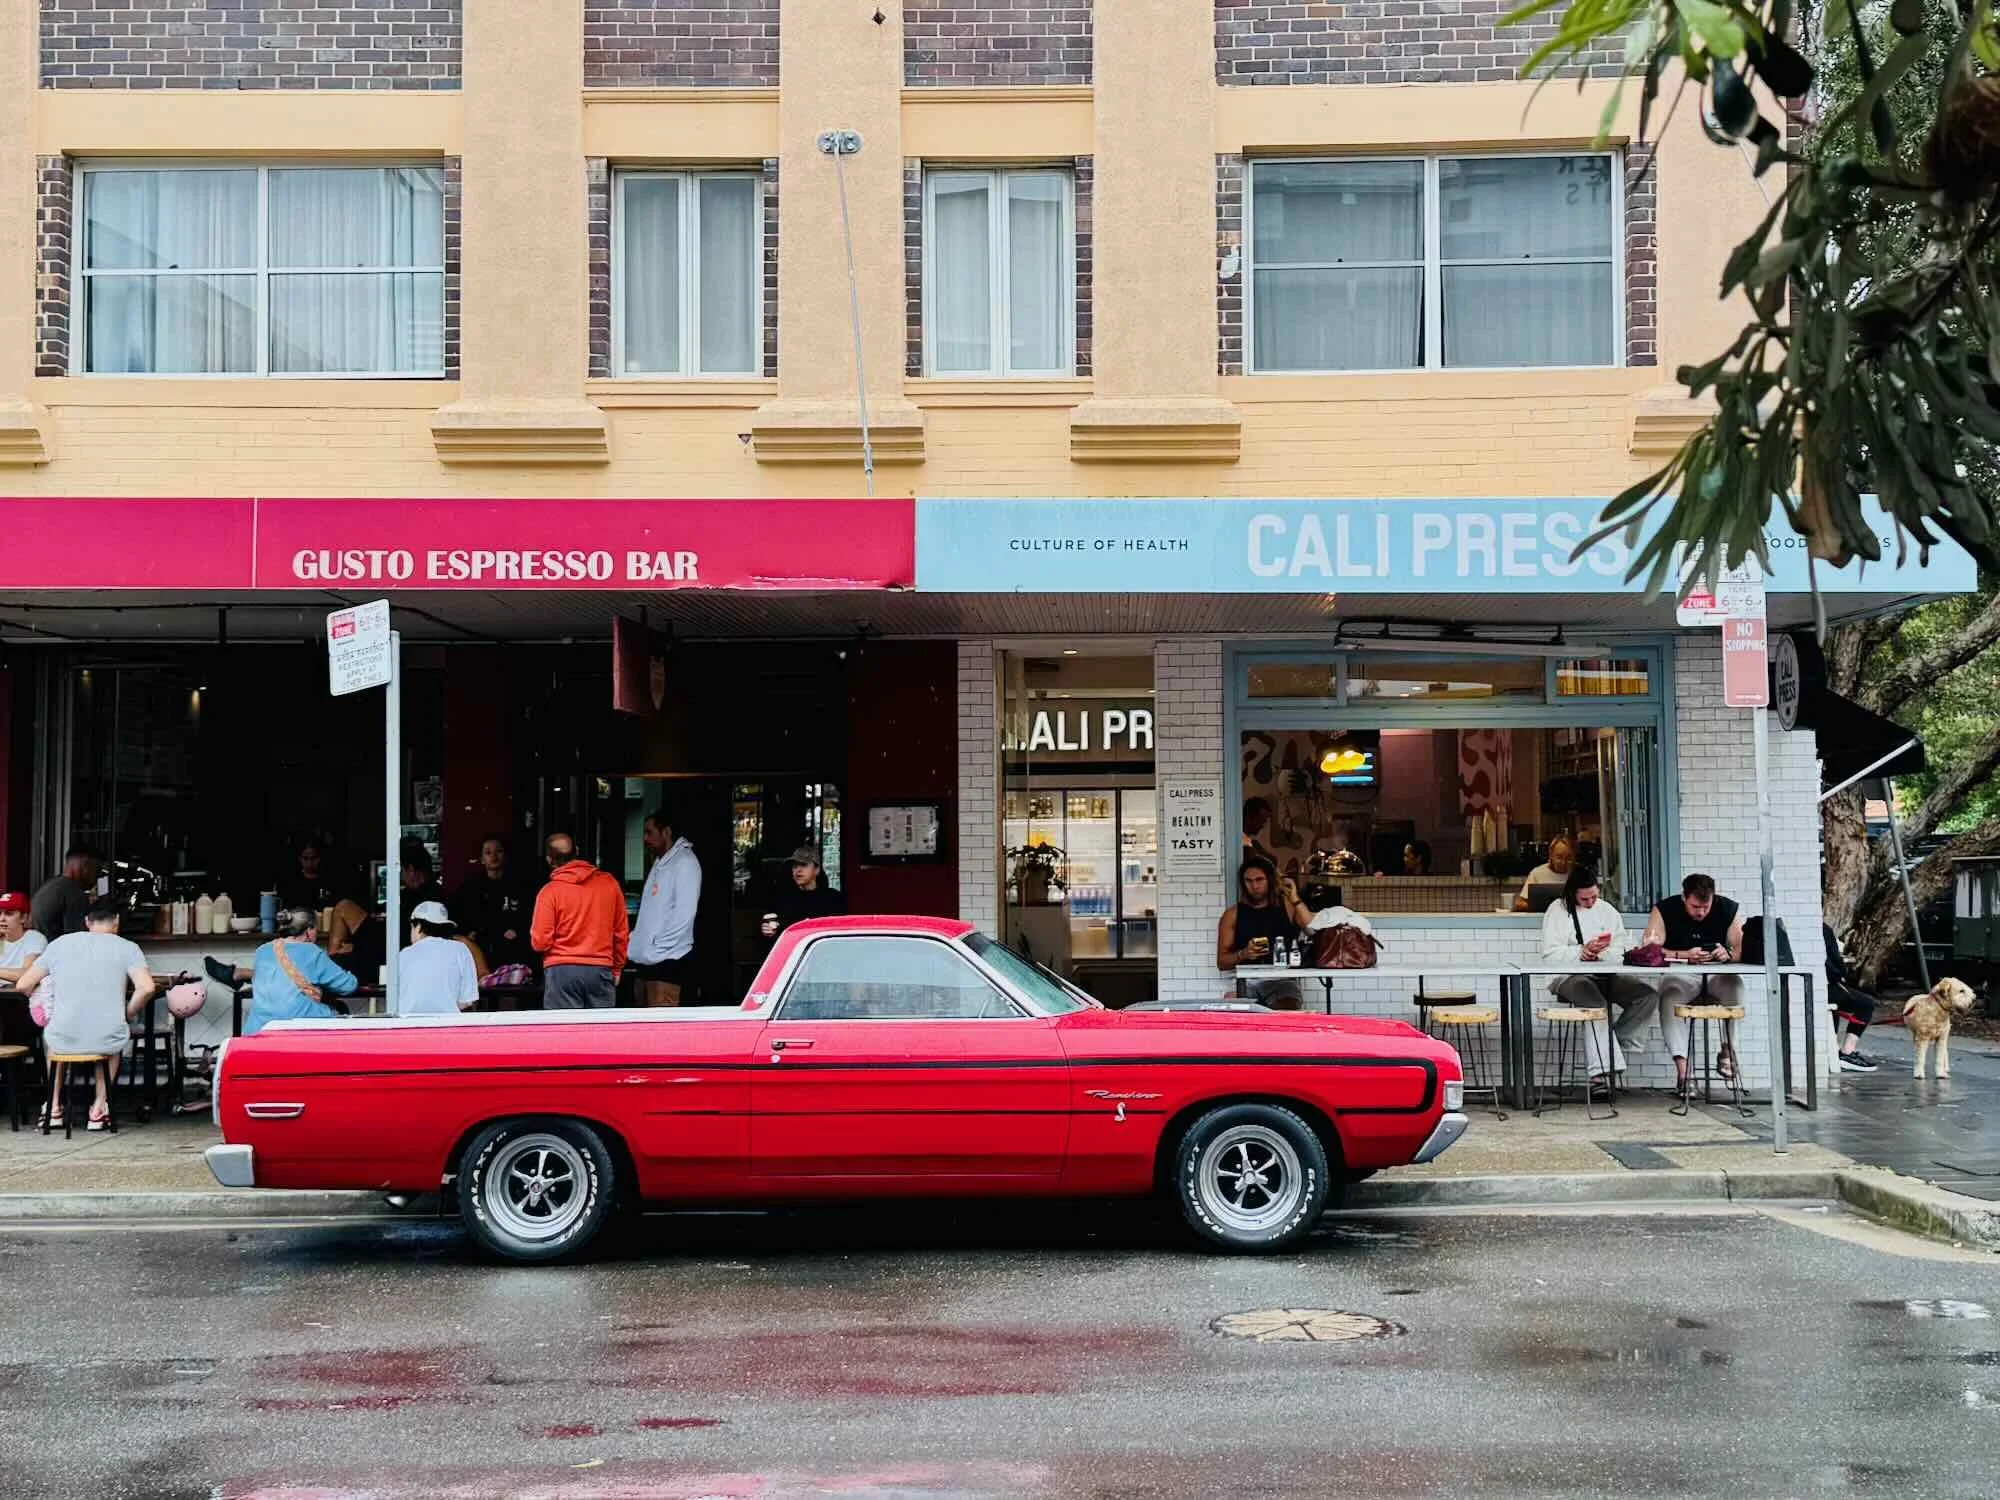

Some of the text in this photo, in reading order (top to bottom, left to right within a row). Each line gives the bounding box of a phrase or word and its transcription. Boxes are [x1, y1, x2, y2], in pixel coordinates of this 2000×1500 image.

[1009, 539, 1188, 550] CULTURE OF HEALTH
[1247, 511, 1630, 577] CALI PRESS
[292, 549, 699, 581] GUSTO ESPRESSO BAR
[1736, 622, 1753, 637] NO
[1001, 710, 1089, 751] ALI
[1169, 788, 1214, 798] CALI PRESS
[1172, 815, 1213, 828] HEALTHY
[1171, 839, 1214, 850] TASTY
[1187, 1179, 1225, 1234] RADIAL
[1282, 1167, 1316, 1235] GALAXY
